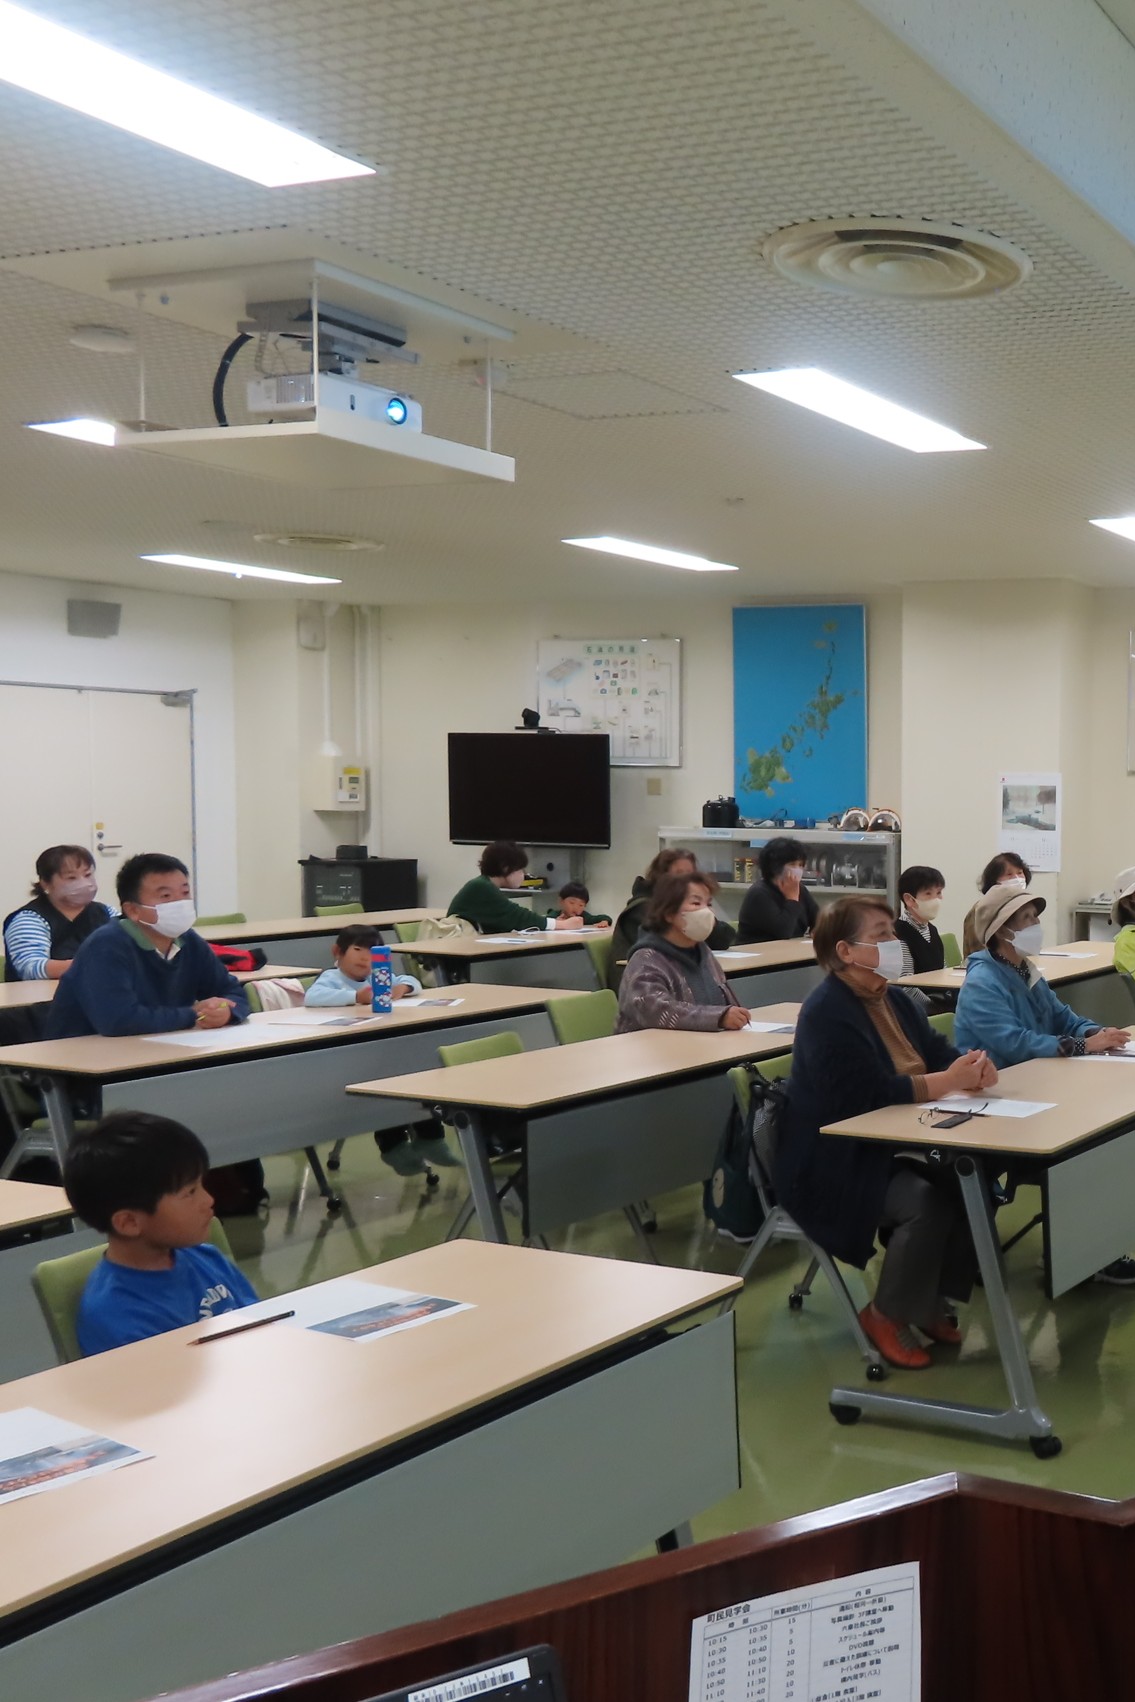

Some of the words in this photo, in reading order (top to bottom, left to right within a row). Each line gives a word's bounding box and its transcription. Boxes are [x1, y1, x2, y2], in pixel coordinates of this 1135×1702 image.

[706, 1603, 751, 1623] 町民見学会
[788, 1617, 796, 1625] 15
[787, 1648, 795, 1656] 10
[786, 1659, 795, 1667] 20
[785, 1680, 794, 1688] 10
[785, 1690, 794, 1699] 20
